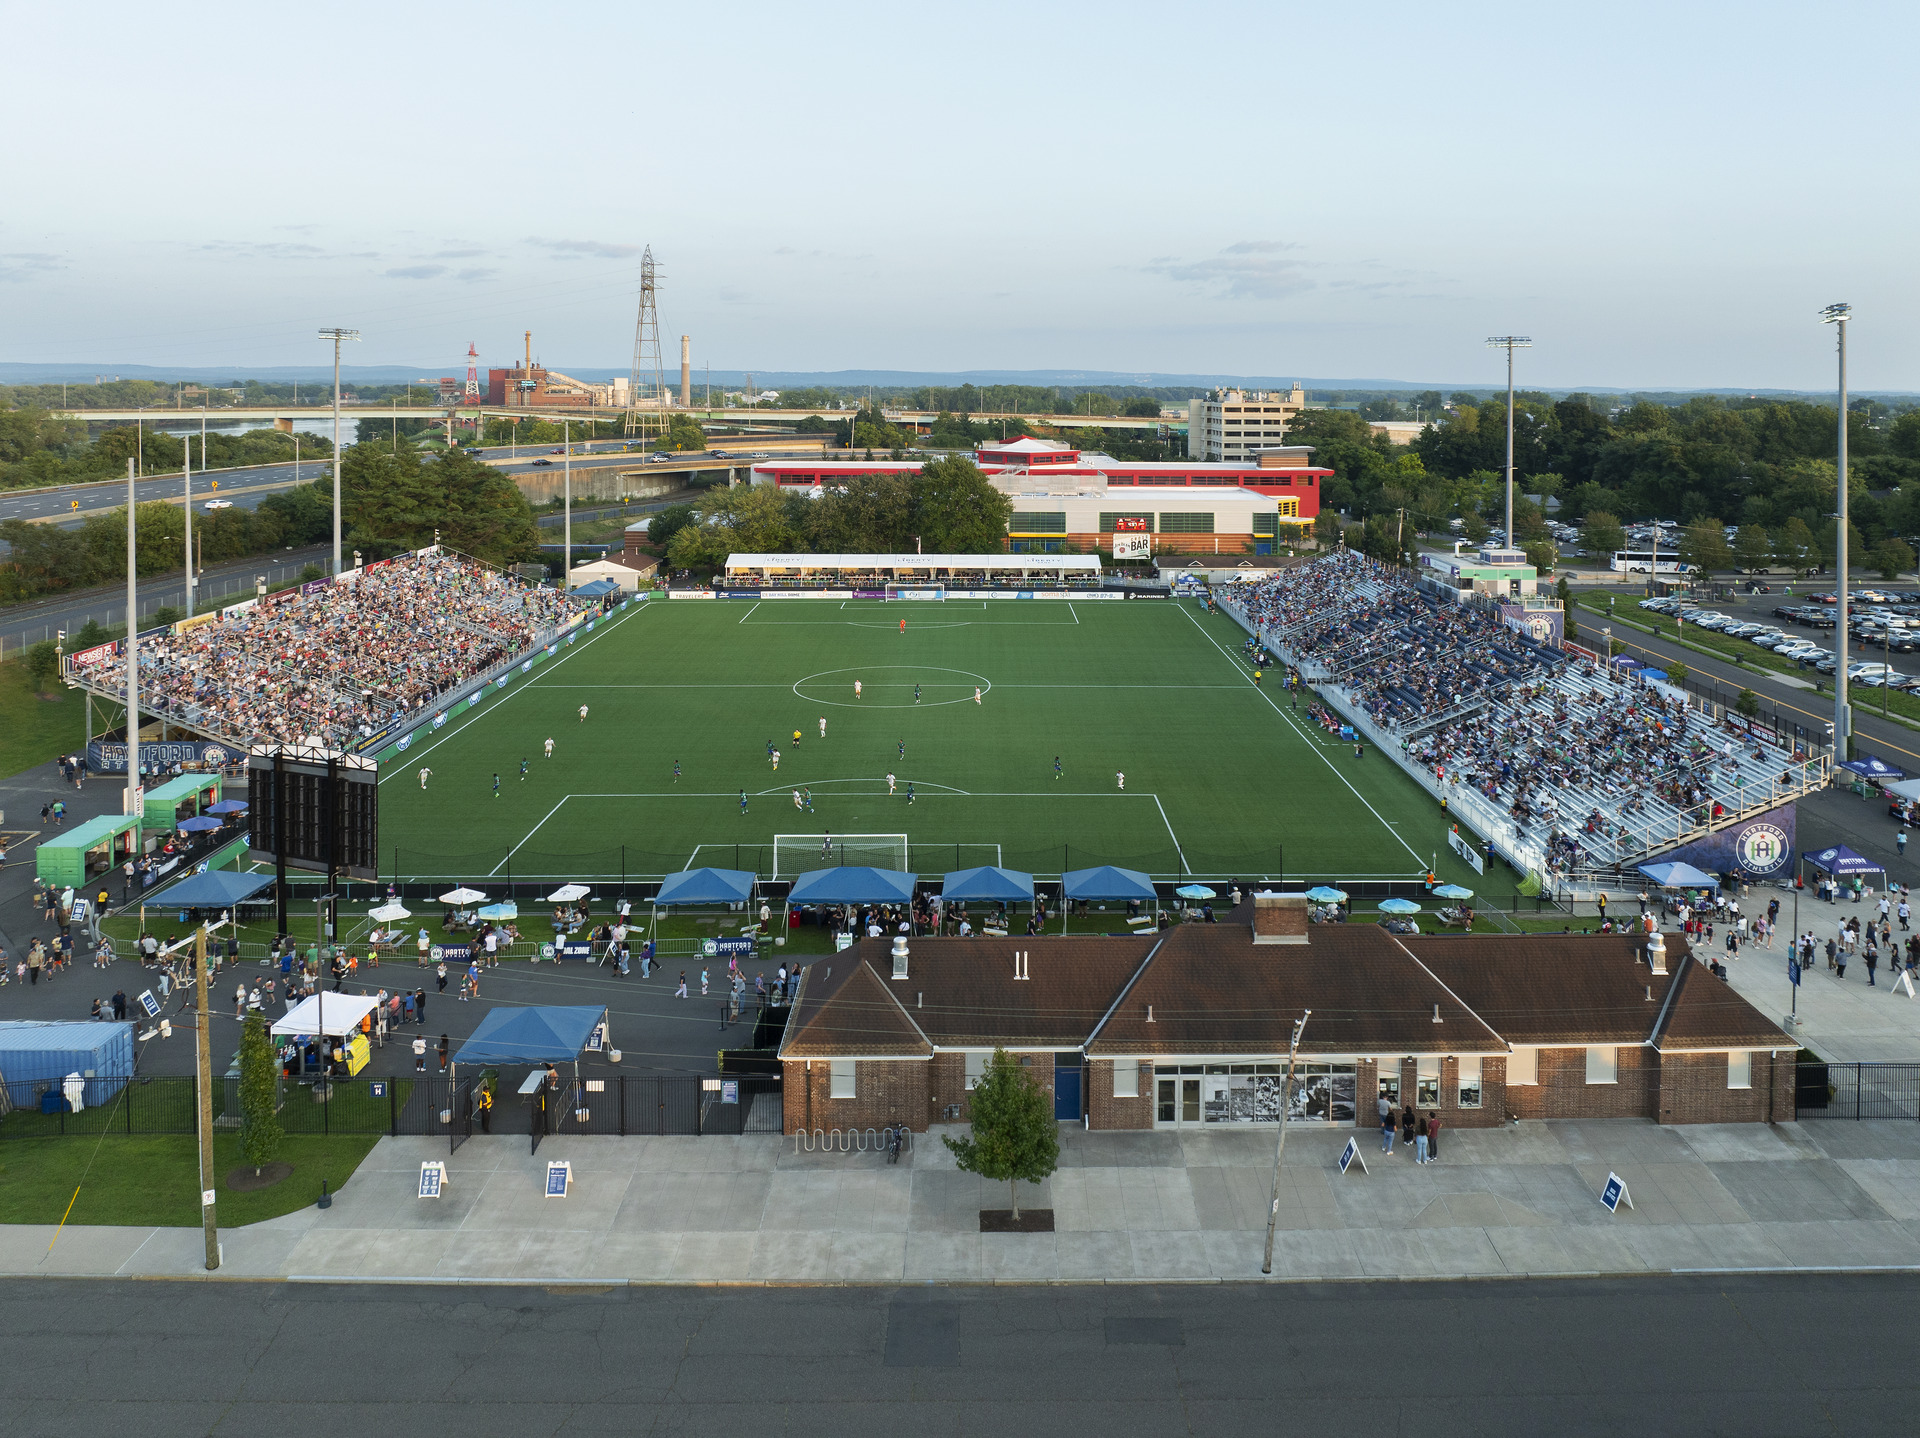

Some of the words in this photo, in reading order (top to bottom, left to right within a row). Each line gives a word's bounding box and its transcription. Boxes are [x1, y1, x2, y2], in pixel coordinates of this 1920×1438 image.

[1131, 539, 1148, 551] BAR
[101, 745, 195, 761] HATFORD
[1741, 825, 1785, 842] HARTFORD
[1742, 857, 1783, 872] ATHLETIC
[574, 946, 590, 955] ZONE
